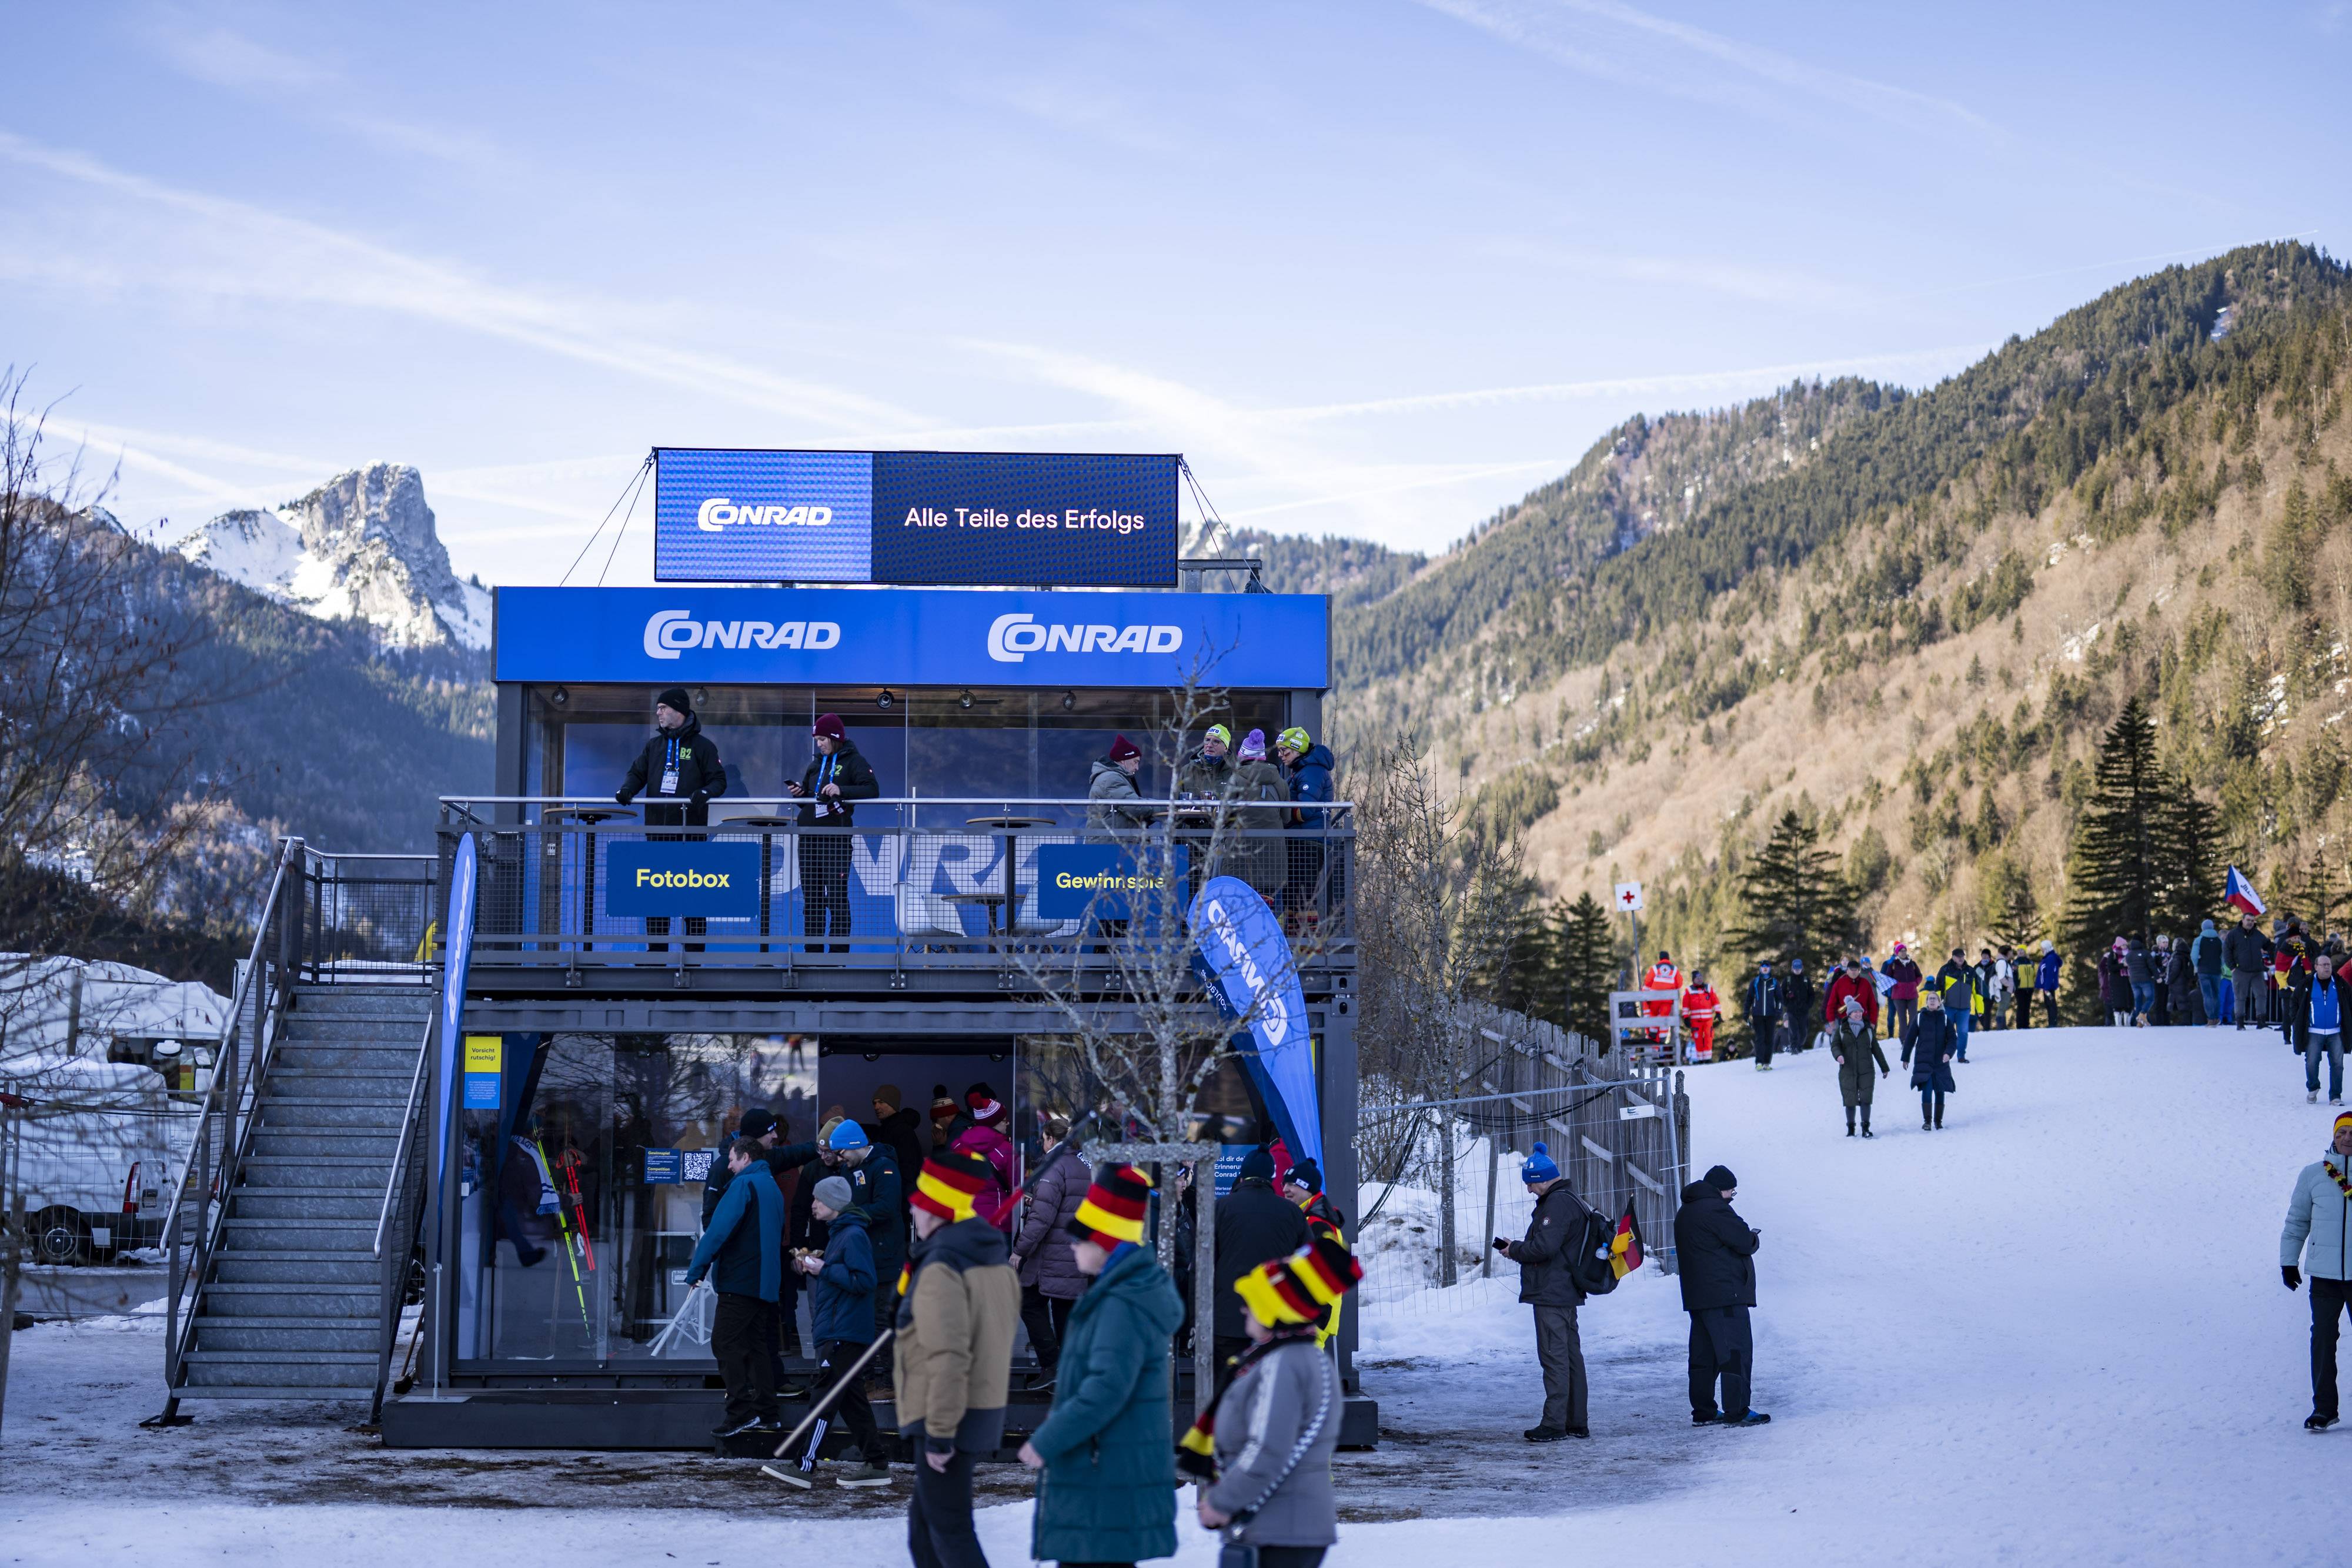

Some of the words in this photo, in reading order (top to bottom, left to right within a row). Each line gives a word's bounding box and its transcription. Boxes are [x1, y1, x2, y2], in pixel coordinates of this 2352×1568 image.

[697, 498, 832, 532] CONRAD
[904, 507, 948, 527] Alle
[954, 508, 1009, 528] Teile
[1016, 509, 1058, 529] des
[1065, 508, 1144, 534] Erfolgs
[643, 610, 841, 659] CONRAD
[987, 613, 1183, 663] CONRAD
[680, 747, 691, 759] B2
[636, 868, 730, 888] Fotobox
[1056, 872, 1165, 892] Gewinnspie
